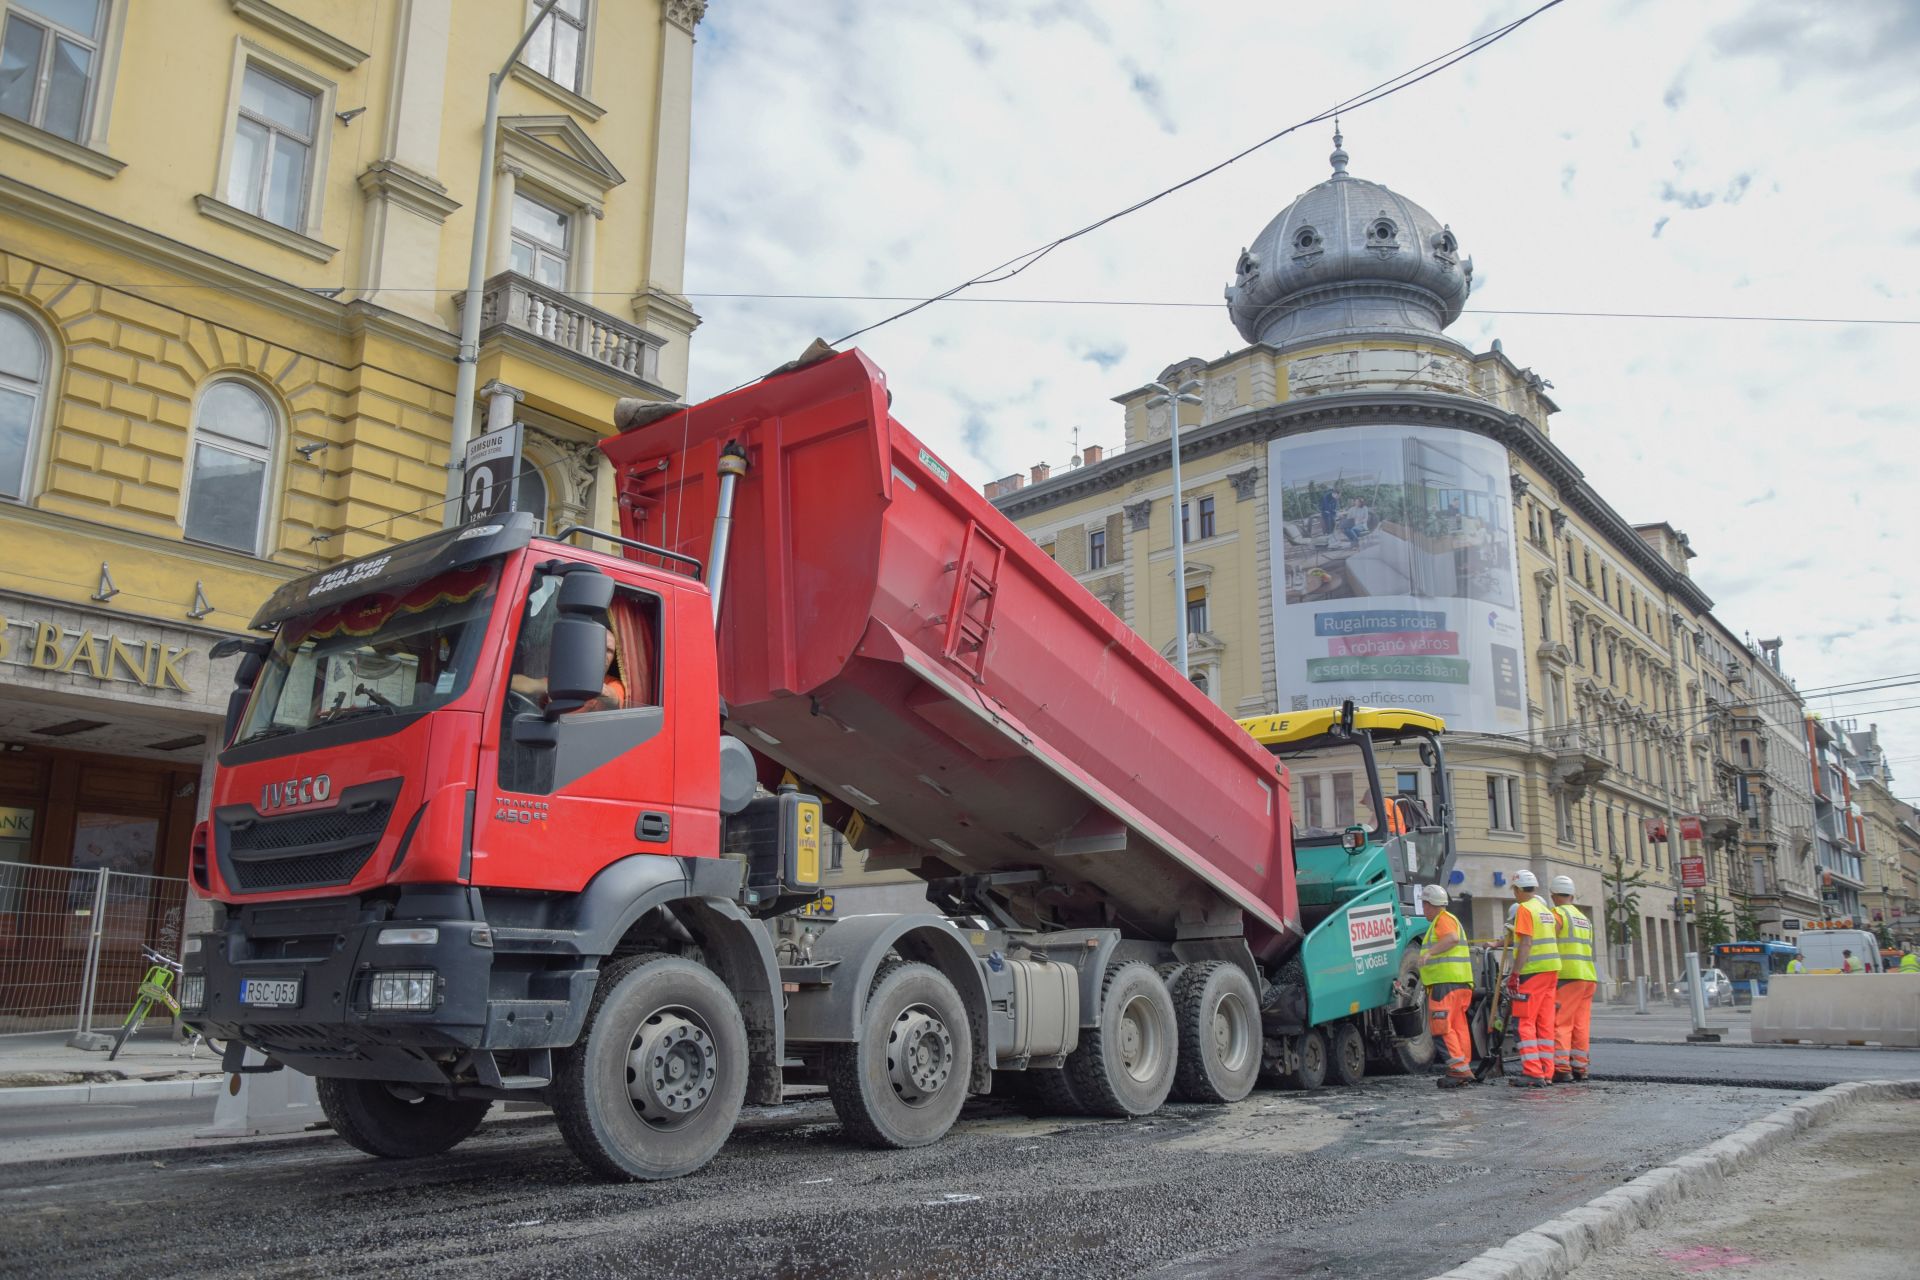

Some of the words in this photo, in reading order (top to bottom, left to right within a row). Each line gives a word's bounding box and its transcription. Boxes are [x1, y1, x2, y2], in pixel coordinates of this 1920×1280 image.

[470, 436, 503, 456] SAMSUNG
[352, 555, 392, 575] Trans
[1324, 615, 1397, 632] Rugalmas
[1401, 615, 1438, 629] iroda
[1338, 645, 1347, 656] a
[1351, 637, 1406, 653] rohanó
[1409, 637, 1450, 650] város
[31, 620, 194, 693] BANK
[1314, 662, 1378, 677] csendes
[261, 774, 331, 810] IVECO
[495, 797, 549, 810] TRAKKER
[0, 815, 30, 830] NK
[495, 808, 531, 824] 450
[1350, 917, 1393, 942] STRABAG
[1364, 952, 1389, 970] VÖGELE
[247, 982, 296, 1002] RSC-053
